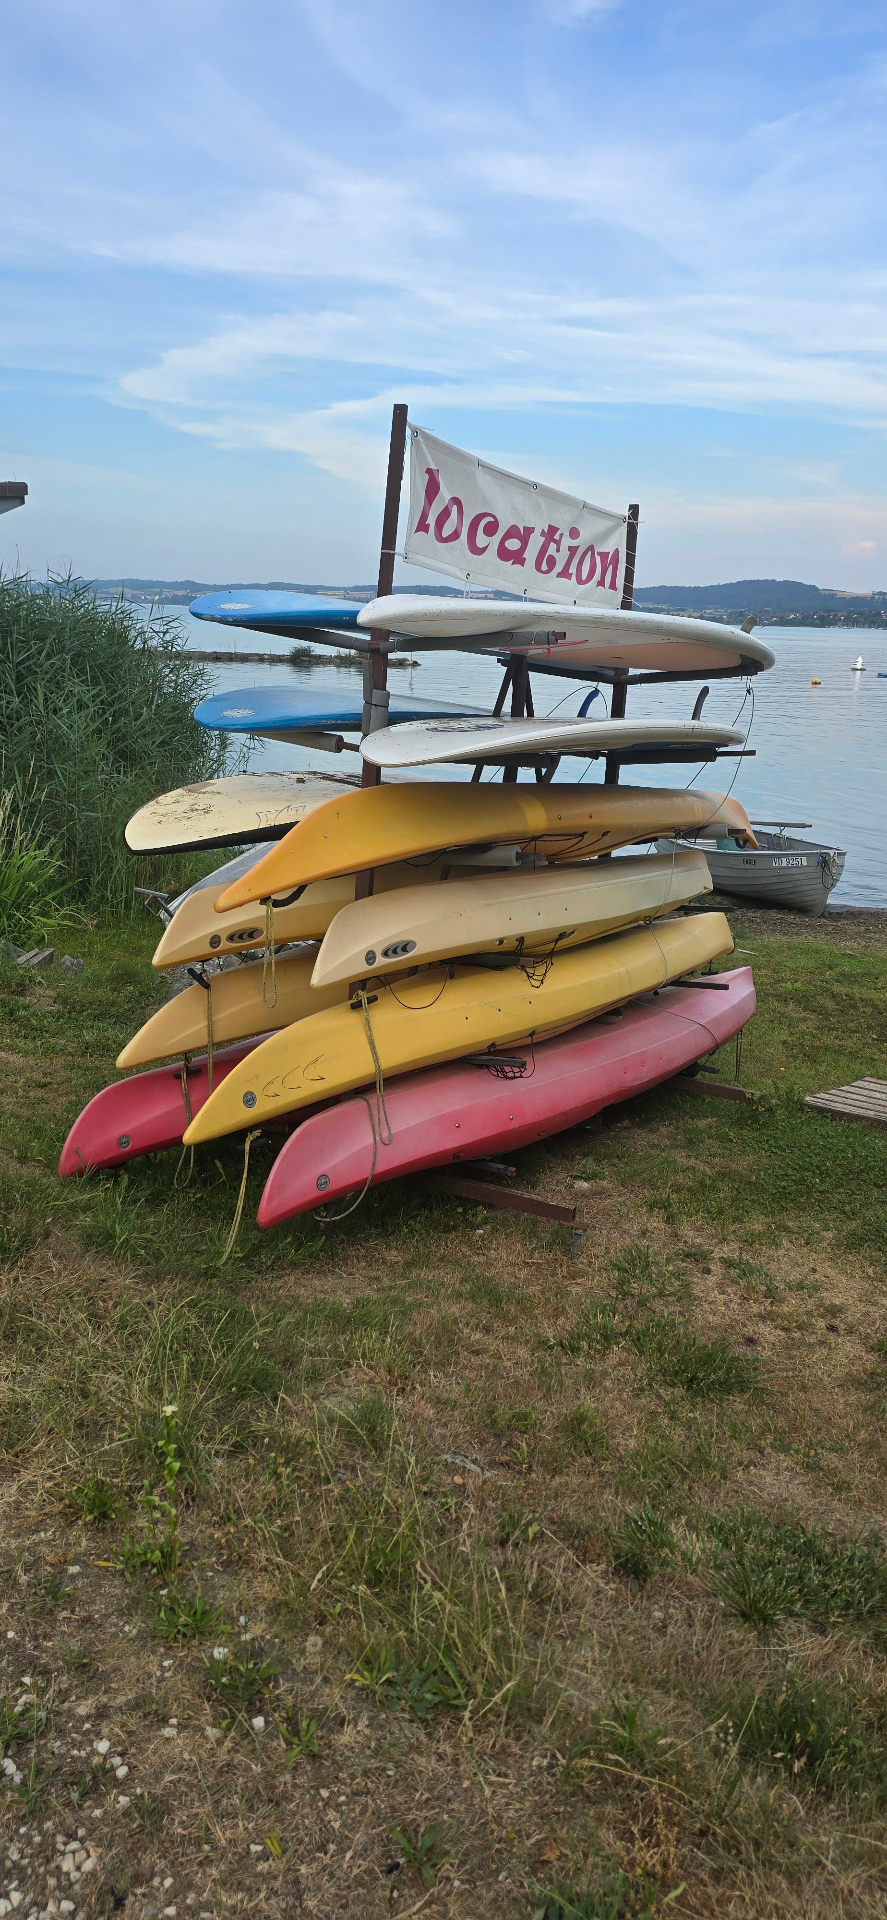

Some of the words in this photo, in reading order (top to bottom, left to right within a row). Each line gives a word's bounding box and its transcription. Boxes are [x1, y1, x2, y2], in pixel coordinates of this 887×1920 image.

[414, 467, 620, 591] location
[773, 857, 783, 866] VD
[785, 857, 804, 866] 9251
